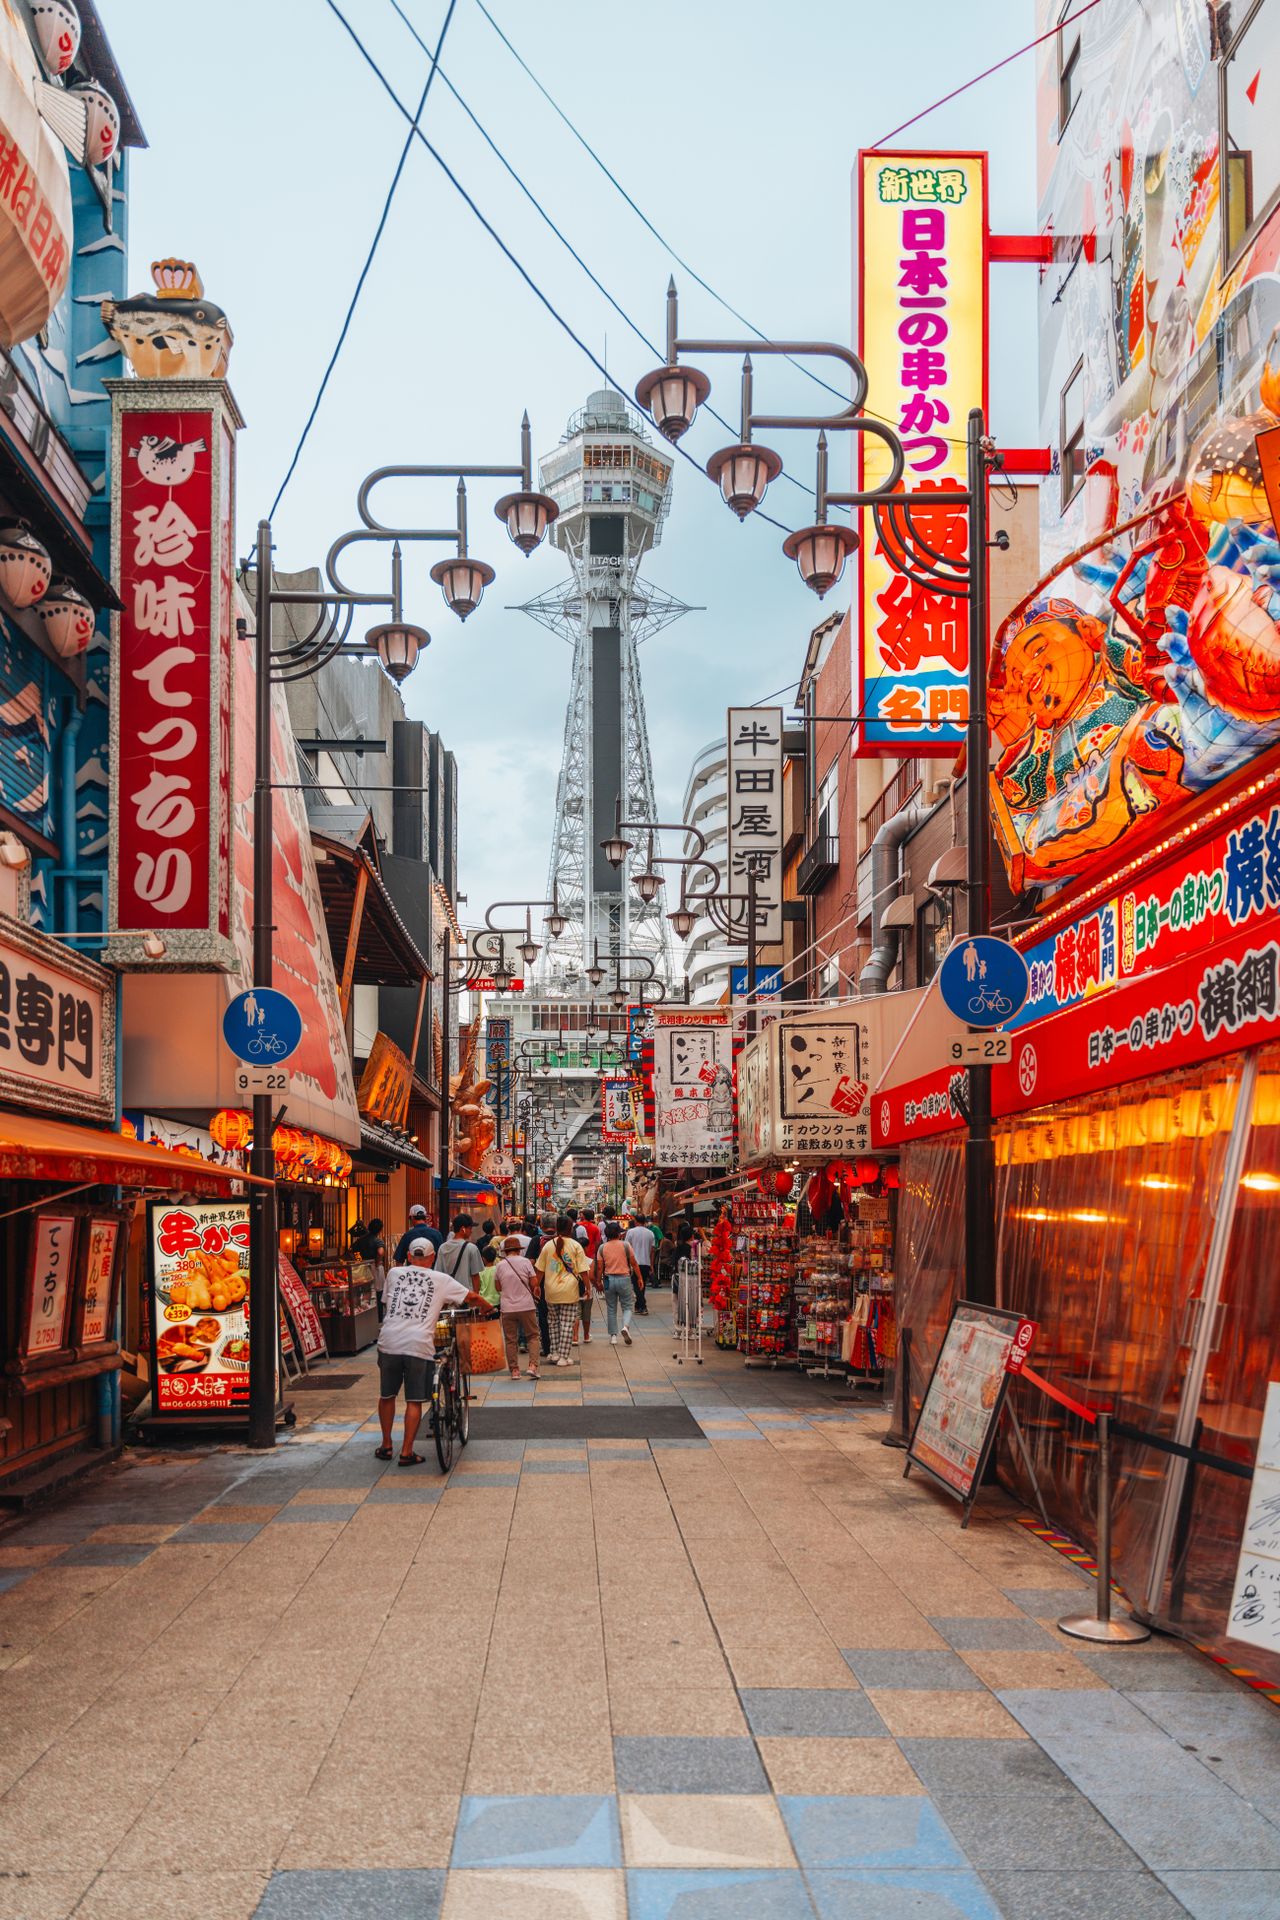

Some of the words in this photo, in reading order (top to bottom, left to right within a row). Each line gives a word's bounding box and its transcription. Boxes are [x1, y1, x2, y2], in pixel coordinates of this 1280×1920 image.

[879, 168, 967, 203] 新世界
[897, 208, 950, 472] 日本一の串かつ
[874, 478, 968, 672] 横綱
[880, 688, 968, 728] 名門
[732, 721, 779, 927] 半田屋酒店
[1123, 894, 1134, 971] 新世界
[1135, 872, 1223, 950] 日本一の串かつ
[1031, 963, 1054, 999] 串かつ
[1055, 914, 1100, 1005] 横綱
[1101, 909, 1115, 982] 名門
[1088, 1004, 1195, 1068] 日本一の串かつ
[1200, 944, 1278, 1037] 横綱
[782, 1124, 794, 1136] 1F
[797, 1124, 868, 1136] カウンター席
[782, 1139, 794, 1150] 2F
[797, 1138, 868, 1150] 座敷あります
[660, 1151, 730, 1163] 宴会予約受付中
[158, 1210, 250, 1259] 串かつ
[199, 1209, 246, 1225] 新世界名物
[399, 1271, 419, 1282] DAY
